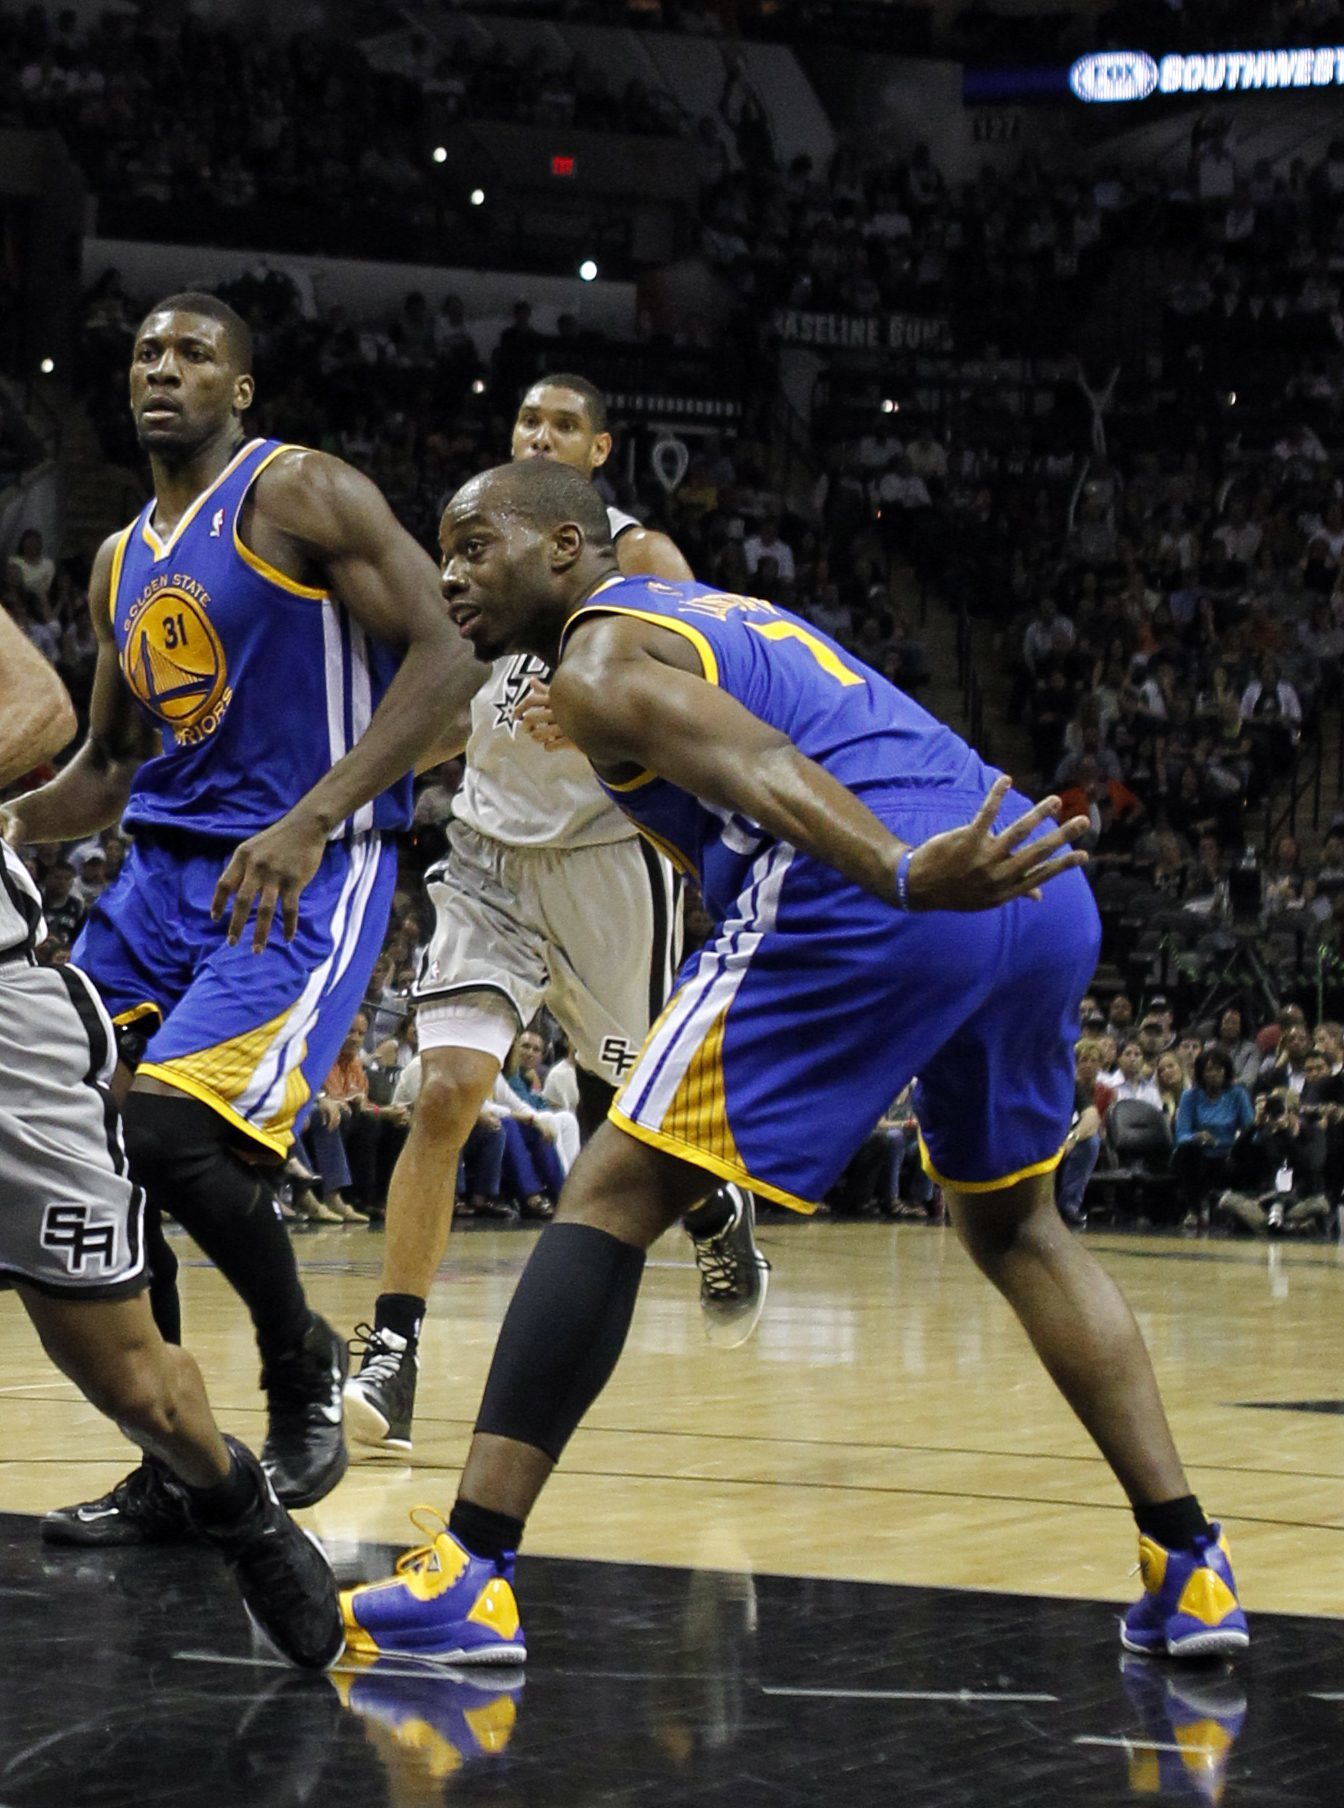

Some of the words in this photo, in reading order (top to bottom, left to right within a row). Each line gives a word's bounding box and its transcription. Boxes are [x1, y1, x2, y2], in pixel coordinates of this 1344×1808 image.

[123, 574, 168, 631] GOLDEN
[172, 573, 212, 607] STATE
[162, 613, 189, 649] 31
[743, 620, 865, 687] 1
[41, 1204, 116, 1273] SA
